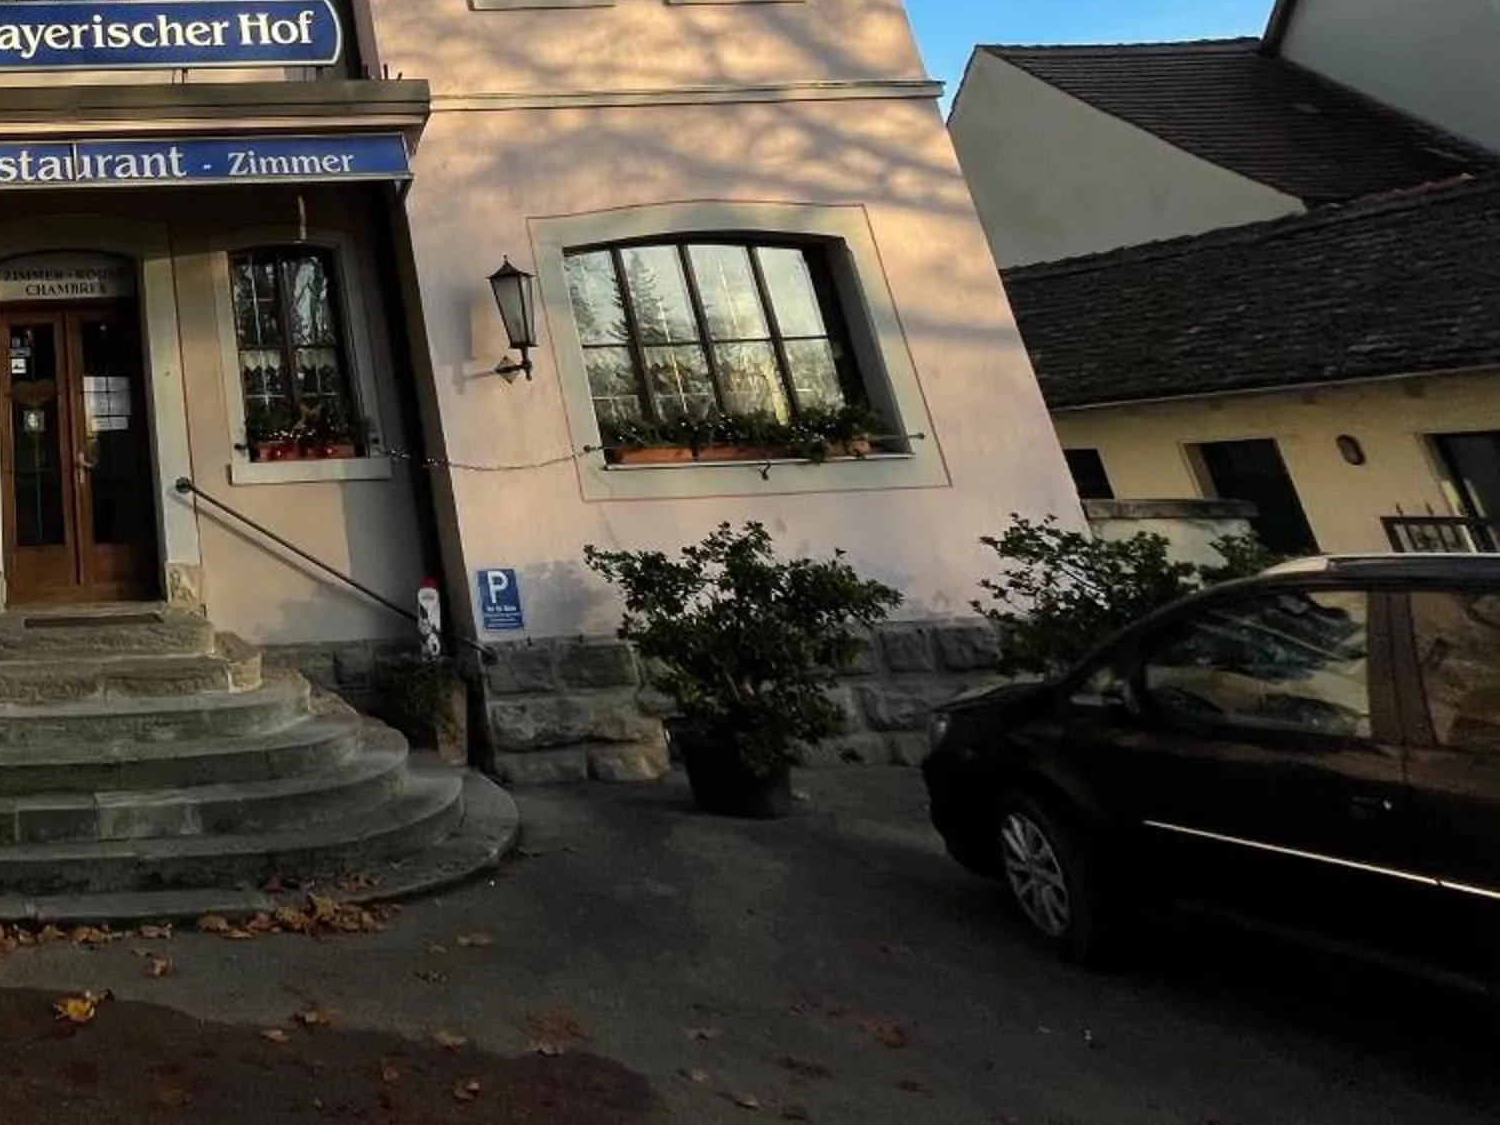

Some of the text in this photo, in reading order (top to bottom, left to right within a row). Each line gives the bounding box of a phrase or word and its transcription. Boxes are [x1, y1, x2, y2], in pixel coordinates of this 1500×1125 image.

[238, 10, 314, 45] Hof
[227, 151, 355, 176] Zimmer
[75, 267, 126, 280] ROO
[487, 570, 509, 604] P
